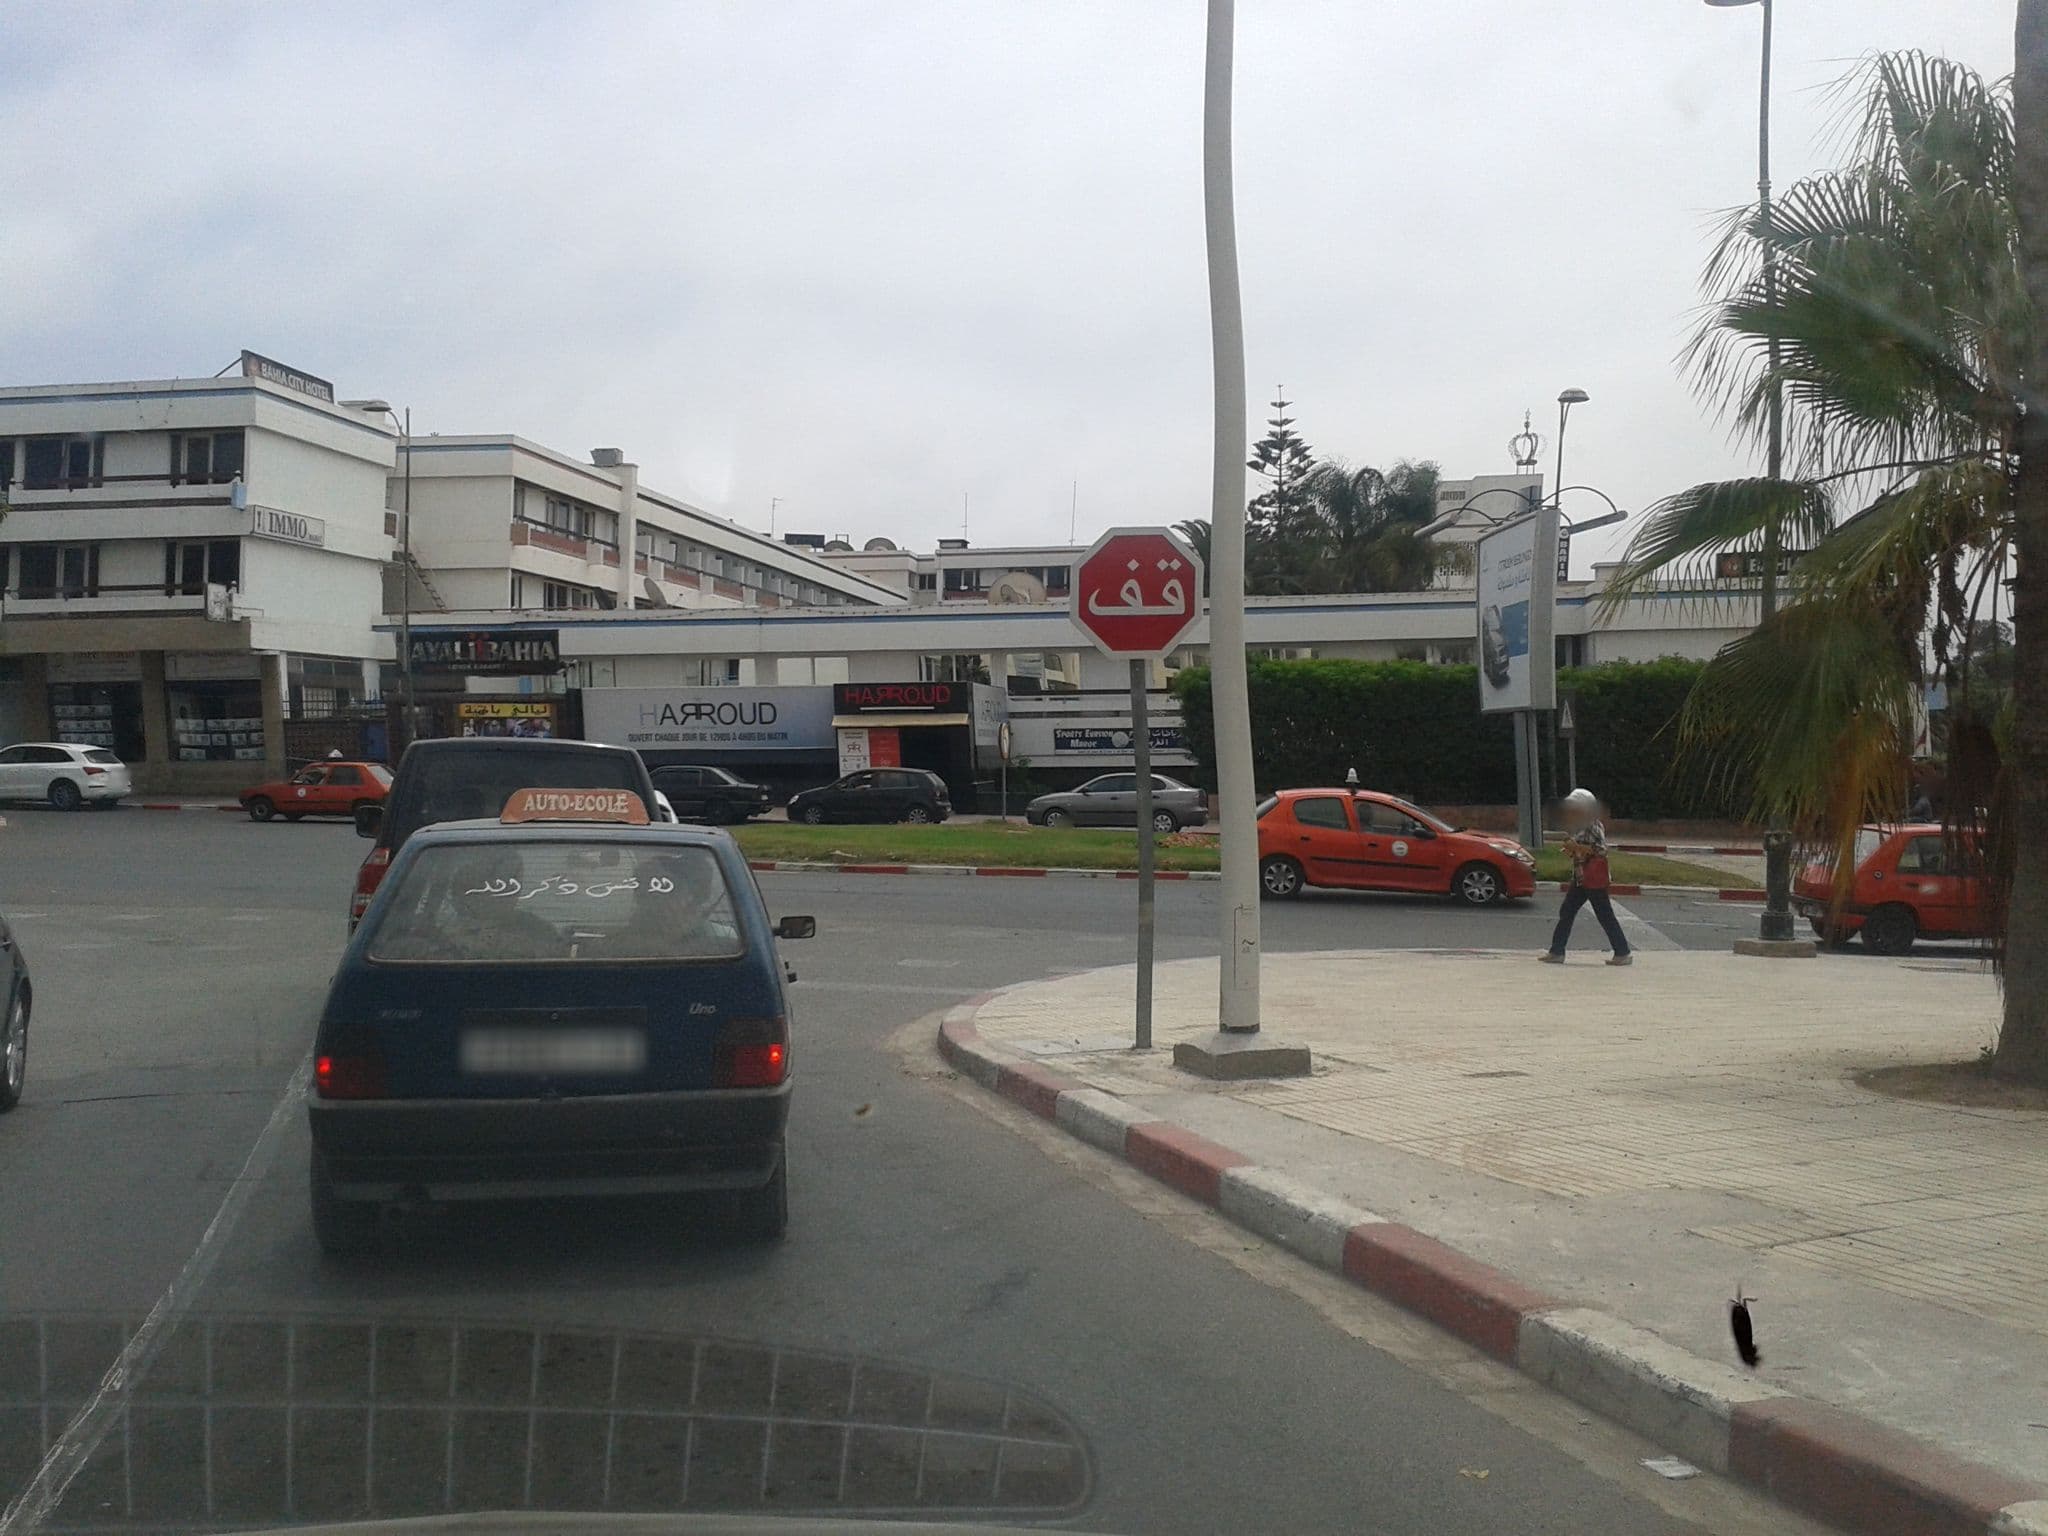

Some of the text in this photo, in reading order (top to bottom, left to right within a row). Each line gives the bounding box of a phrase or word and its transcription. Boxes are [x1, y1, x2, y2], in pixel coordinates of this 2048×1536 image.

[261, 362, 331, 401] BAHIA CITY HOTEL
[268, 511, 307, 539] IMMO
[1087, 558, 1185, 616] قف
[486, 640, 556, 662] BAHIA
[639, 702, 778, 726] HARROUD
[524, 793, 630, 813] AUTO-ECOLE
[689, 1003, 717, 1014] Uno
